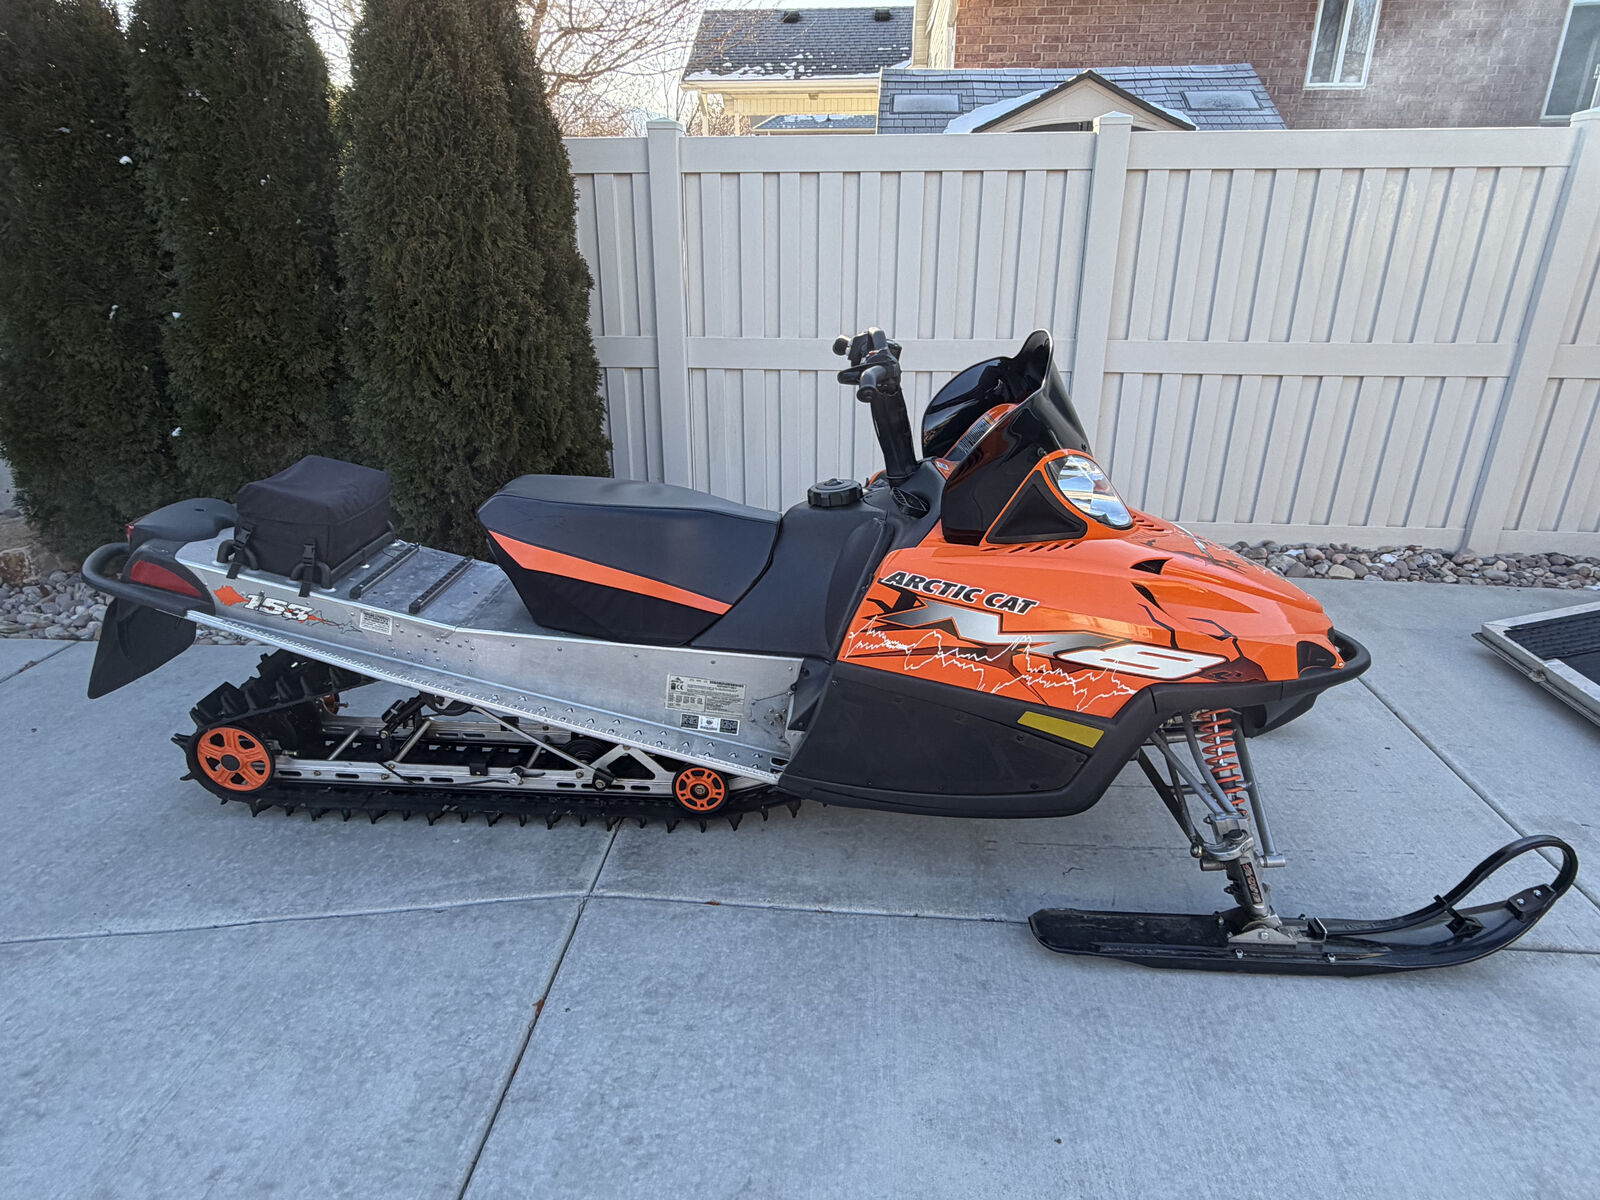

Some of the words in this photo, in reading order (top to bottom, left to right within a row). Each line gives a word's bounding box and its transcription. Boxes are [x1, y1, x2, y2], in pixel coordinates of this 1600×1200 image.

[244, 594, 314, 621] 153
[881, 570, 985, 603] ARCTIC
[983, 592, 1040, 615] CAT
